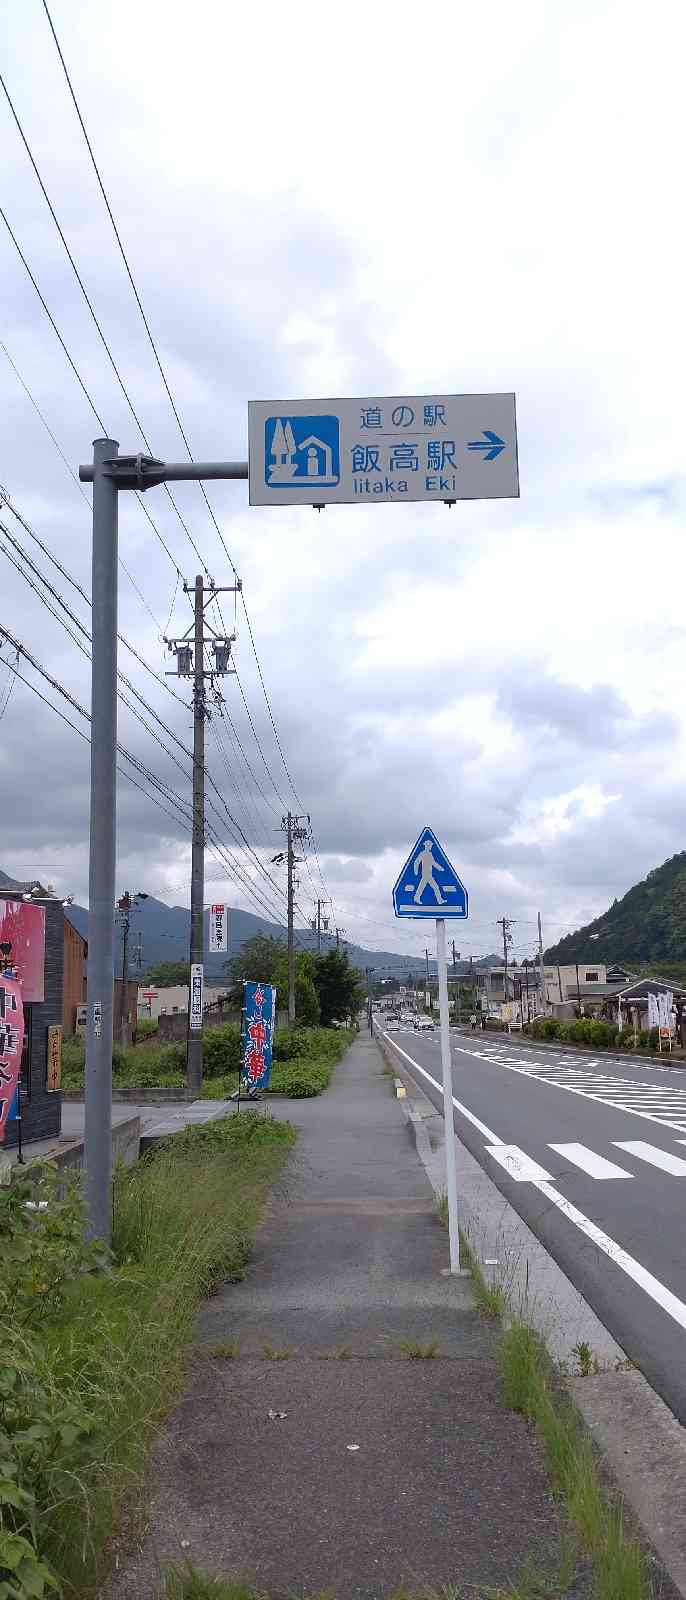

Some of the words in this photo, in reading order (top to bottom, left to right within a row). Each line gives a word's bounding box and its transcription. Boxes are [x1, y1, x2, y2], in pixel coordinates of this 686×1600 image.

[359, 404, 448, 429] 道の駅
[351, 440, 458, 473] 飯高駅
[353, 477, 409, 495] Iitaka
[425, 475, 456, 491] Eki
